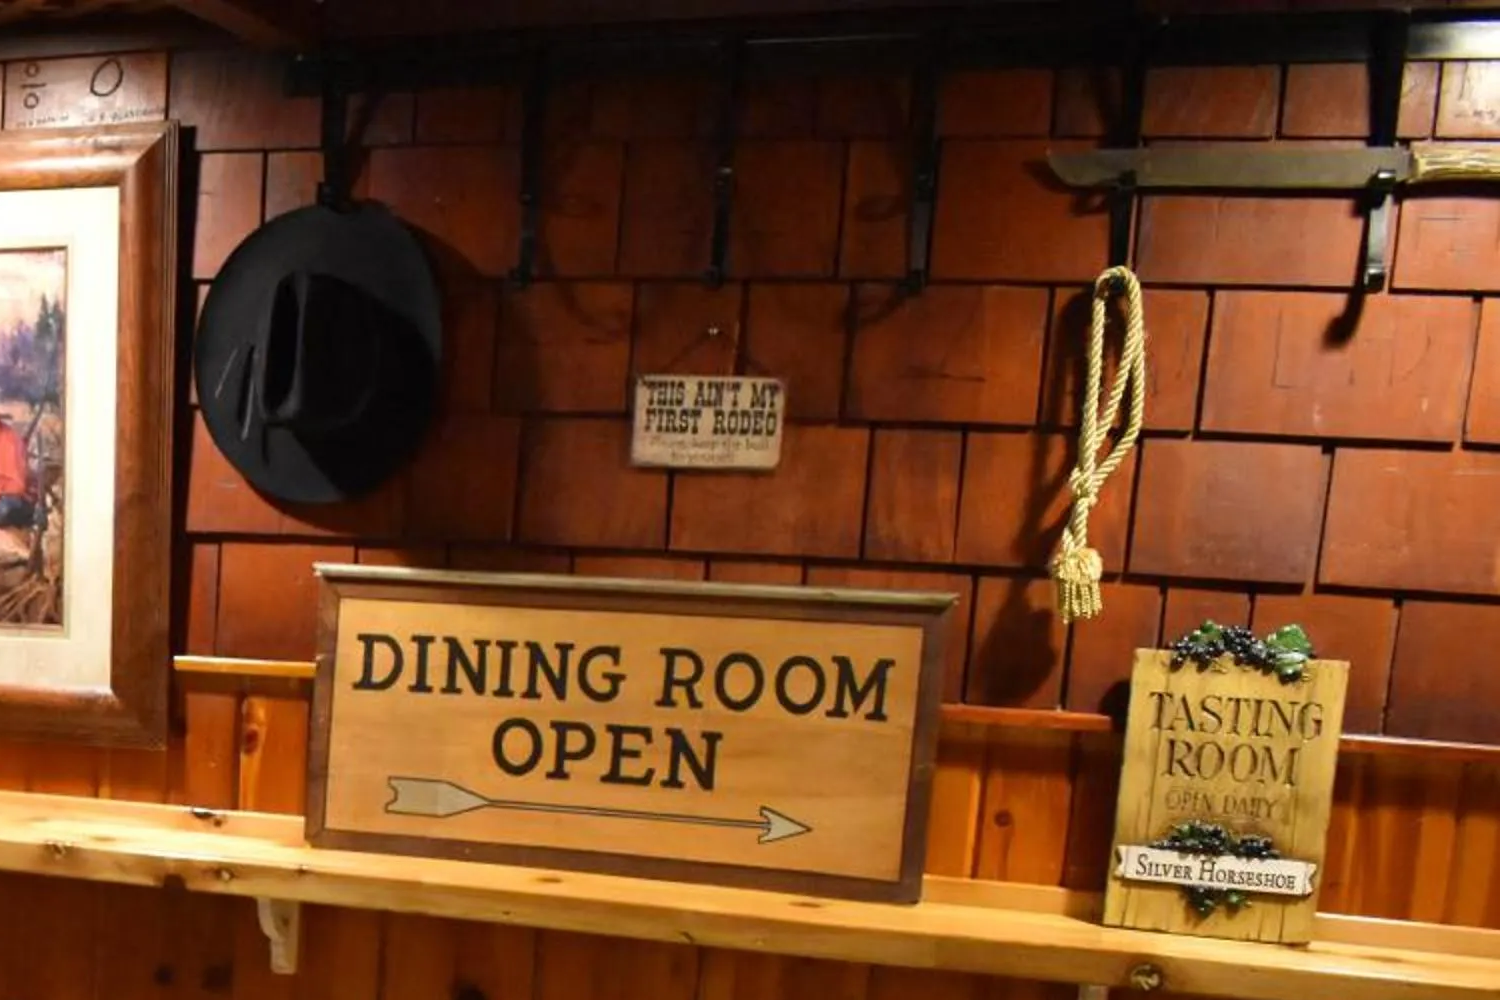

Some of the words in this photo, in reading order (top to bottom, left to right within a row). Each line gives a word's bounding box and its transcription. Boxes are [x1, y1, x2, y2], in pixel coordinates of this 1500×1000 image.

[646, 380, 686, 406] THIS
[694, 380, 742, 408] AIN'T
[750, 382, 780, 409] MY
[644, 408, 702, 434] FIRST
[712, 410, 778, 436] RODEO
[353, 633, 626, 702] DINING
[654, 648, 895, 721] ROOM
[1149, 691, 1324, 741] TASTING
[492, 717, 723, 791] OPEN
[1161, 738, 1300, 786] ROOM
[1135, 853, 1193, 880] SILVER
[1200, 860, 1297, 890] HORSESHOE
